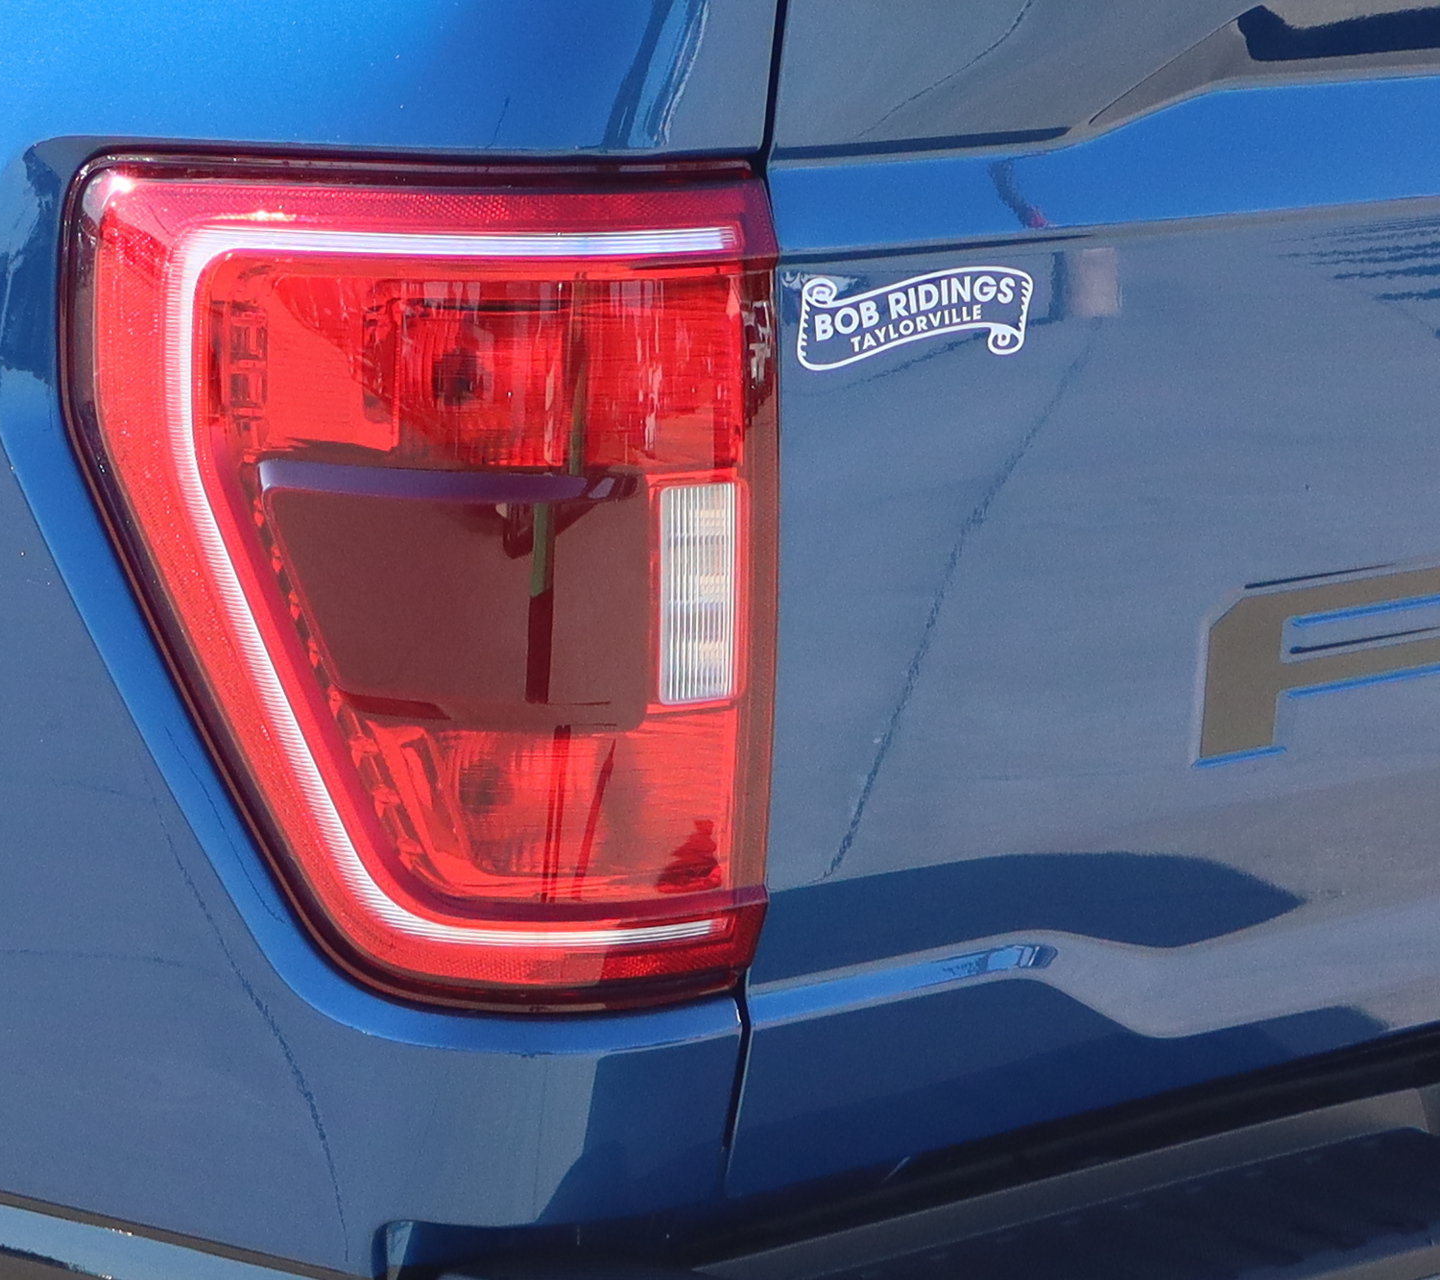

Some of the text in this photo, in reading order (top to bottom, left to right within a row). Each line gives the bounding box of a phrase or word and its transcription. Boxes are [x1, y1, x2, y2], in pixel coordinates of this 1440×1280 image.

[813, 275, 1016, 342] BOB RIDINGS
[850, 304, 983, 353] TAYLORVILLE
